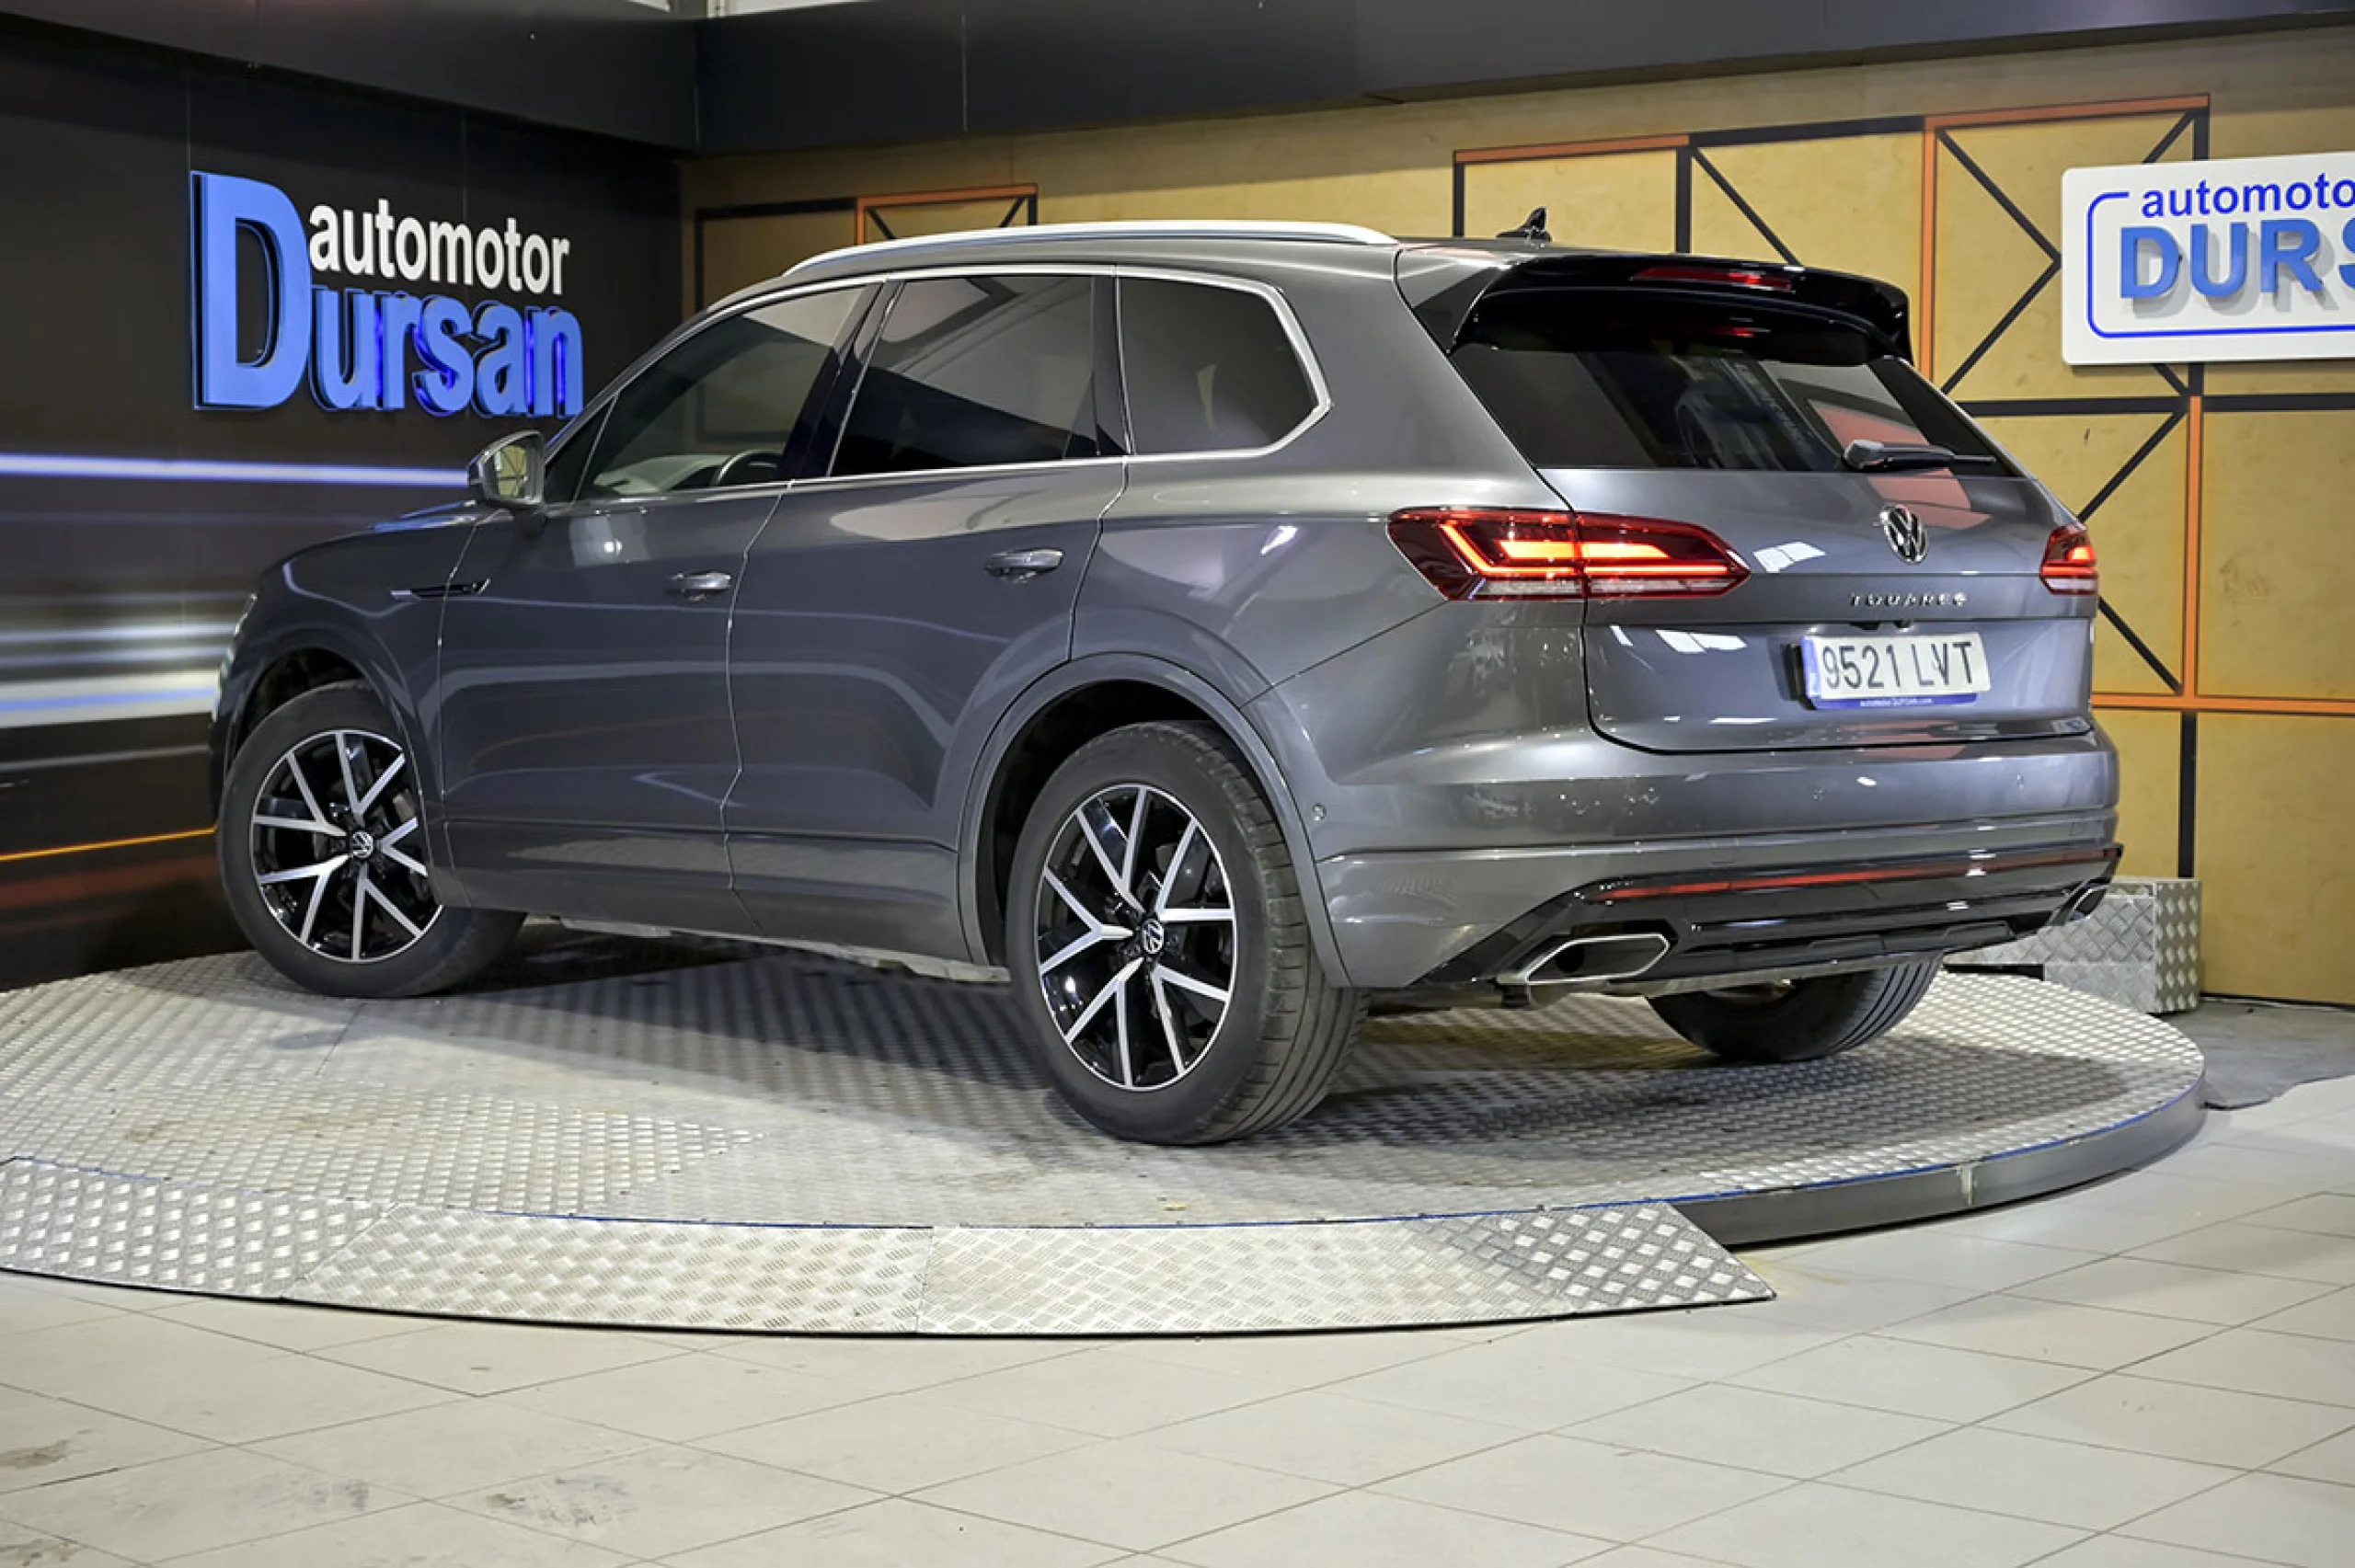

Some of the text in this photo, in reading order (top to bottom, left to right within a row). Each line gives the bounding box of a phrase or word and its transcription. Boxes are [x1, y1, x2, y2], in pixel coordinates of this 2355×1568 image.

[2141, 173, 2355, 218] automoto
[309, 198, 570, 295] automotor
[2120, 216, 2355, 299] DUR
[190, 170, 584, 418] Dursan
[1821, 641, 1973, 690] 9521 LVT
